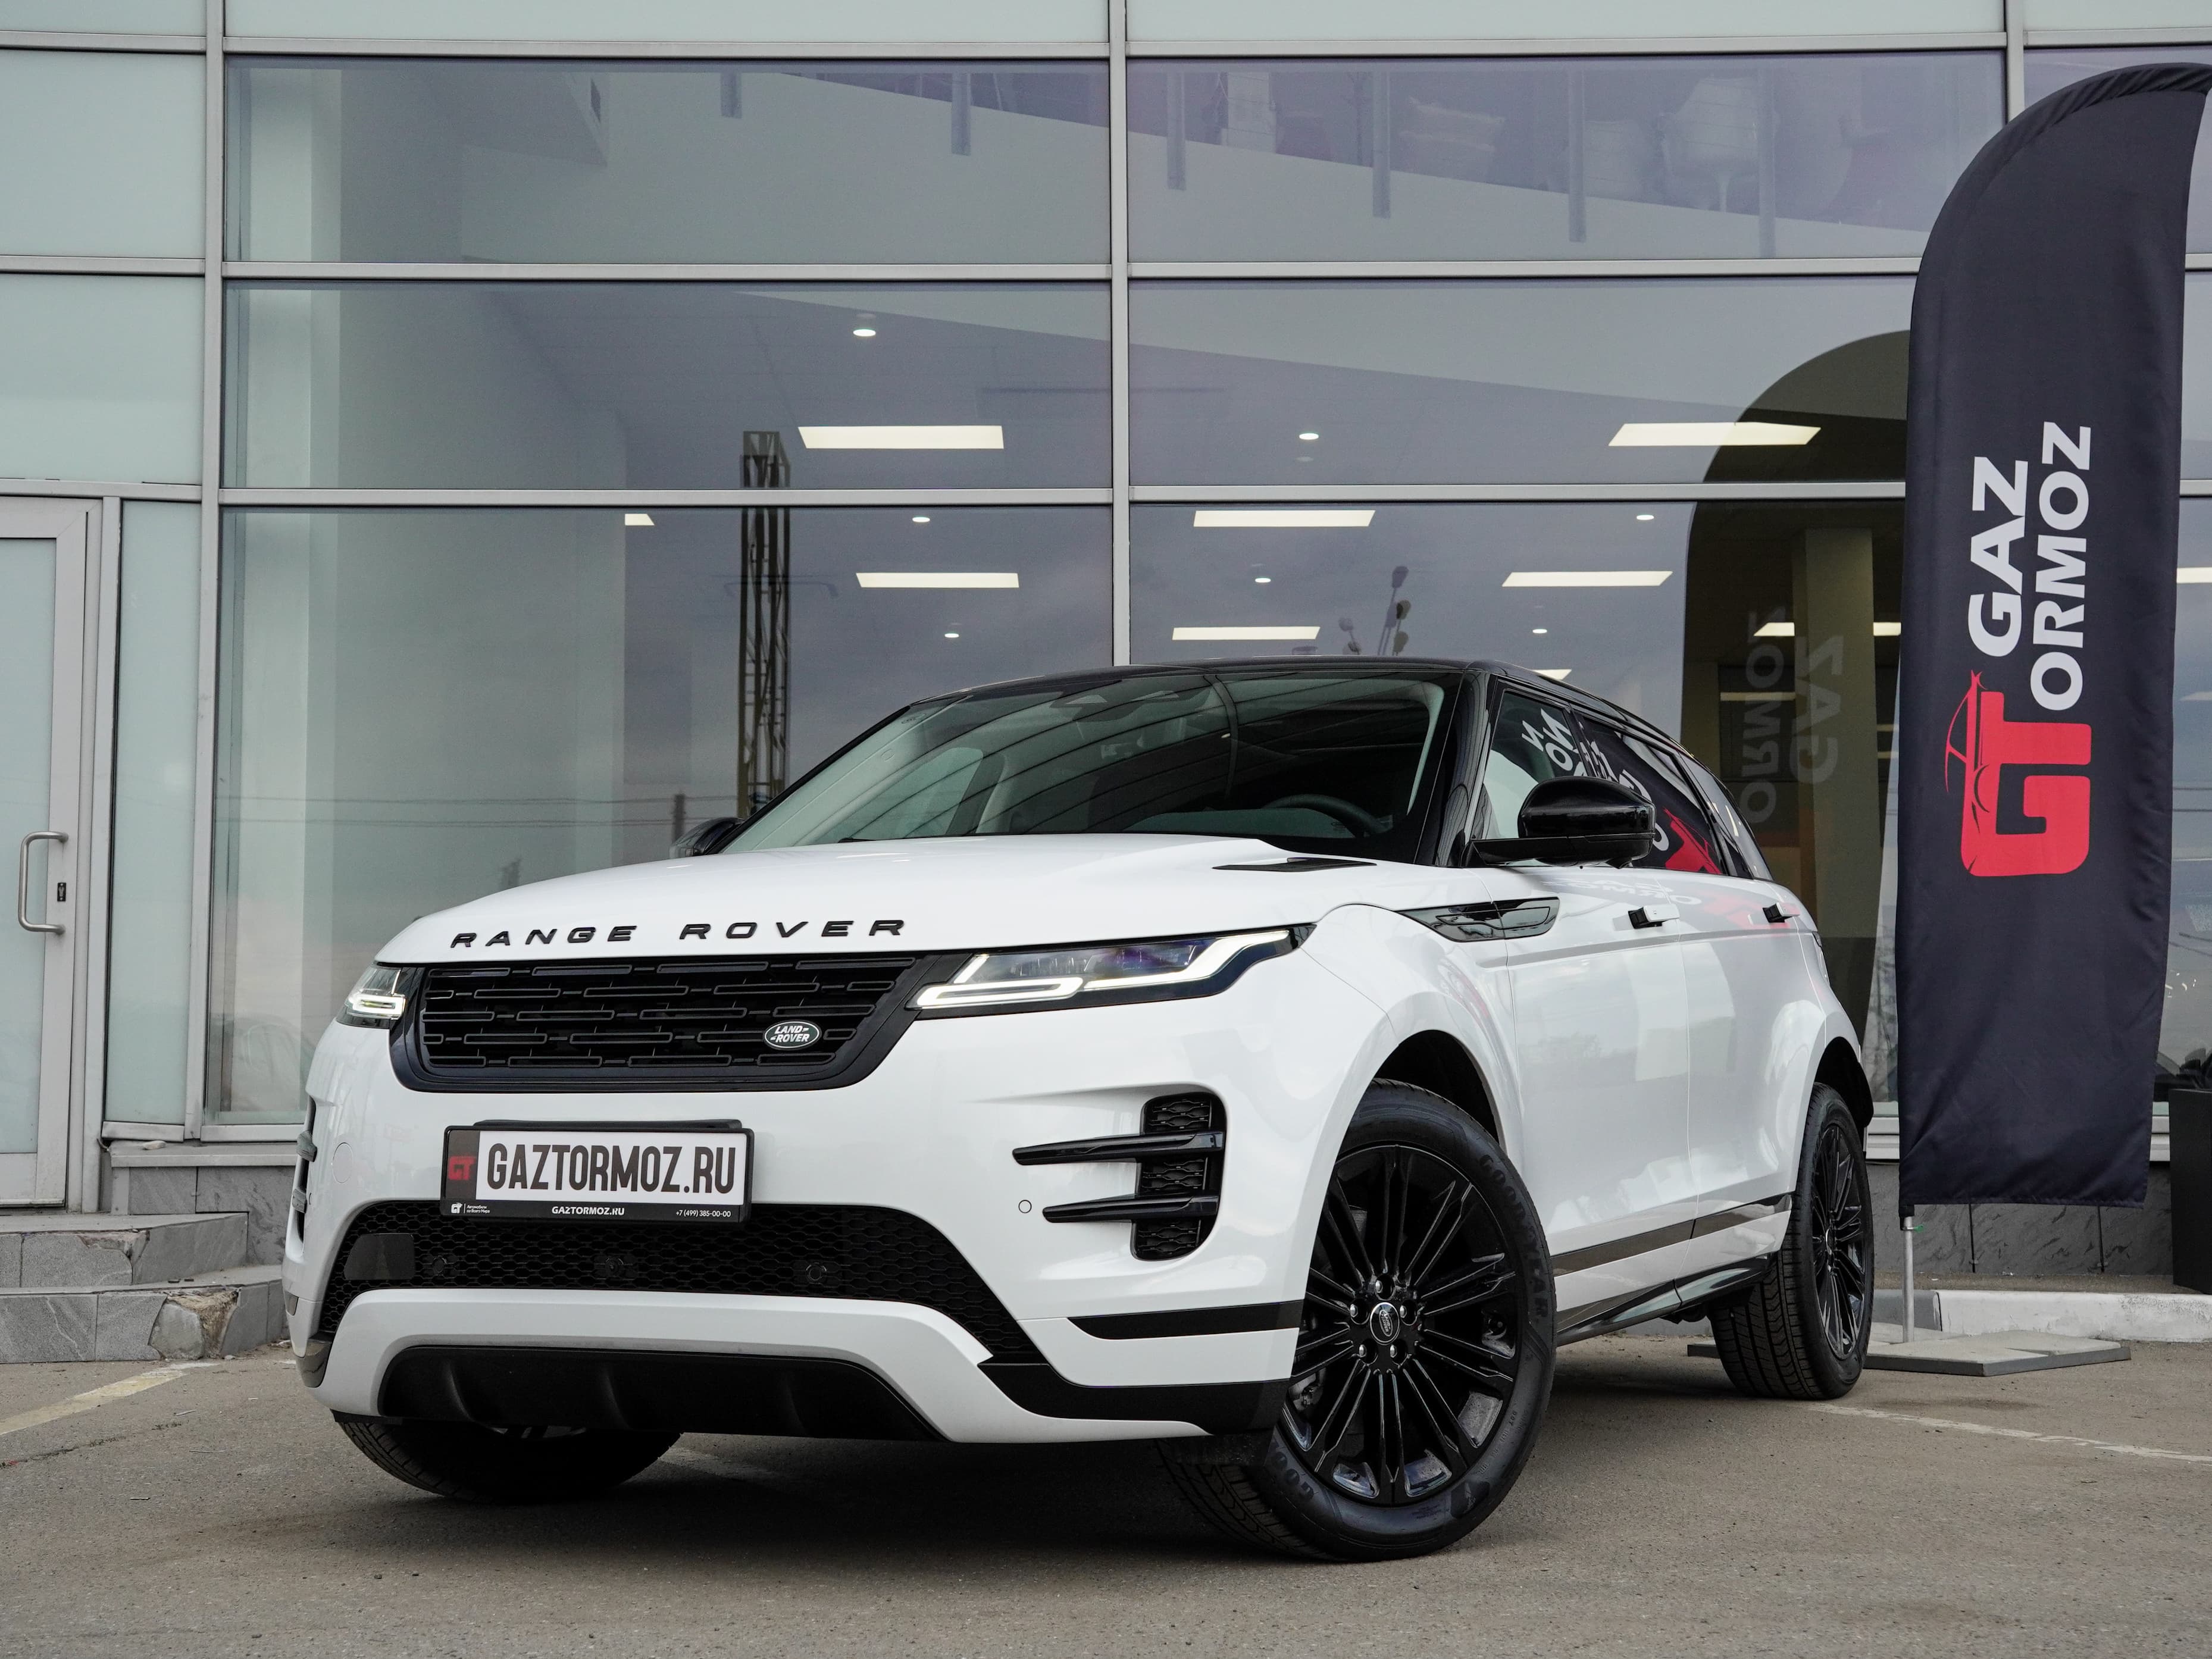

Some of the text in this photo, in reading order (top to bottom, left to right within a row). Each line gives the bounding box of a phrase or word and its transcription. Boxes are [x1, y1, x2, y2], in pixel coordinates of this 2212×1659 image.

[1968, 456, 2028, 657] GAZ
[2030, 421, 2091, 711] ORMOZ
[1957, 678, 2092, 877] GT
[450, 919, 905, 949] RANGE ROVER
[449, 1156, 476, 1181] GT
[487, 1143, 737, 1194] GAZTORMOZ.RU
[552, 1206, 625, 1216] GAZTORMOZ.RU
